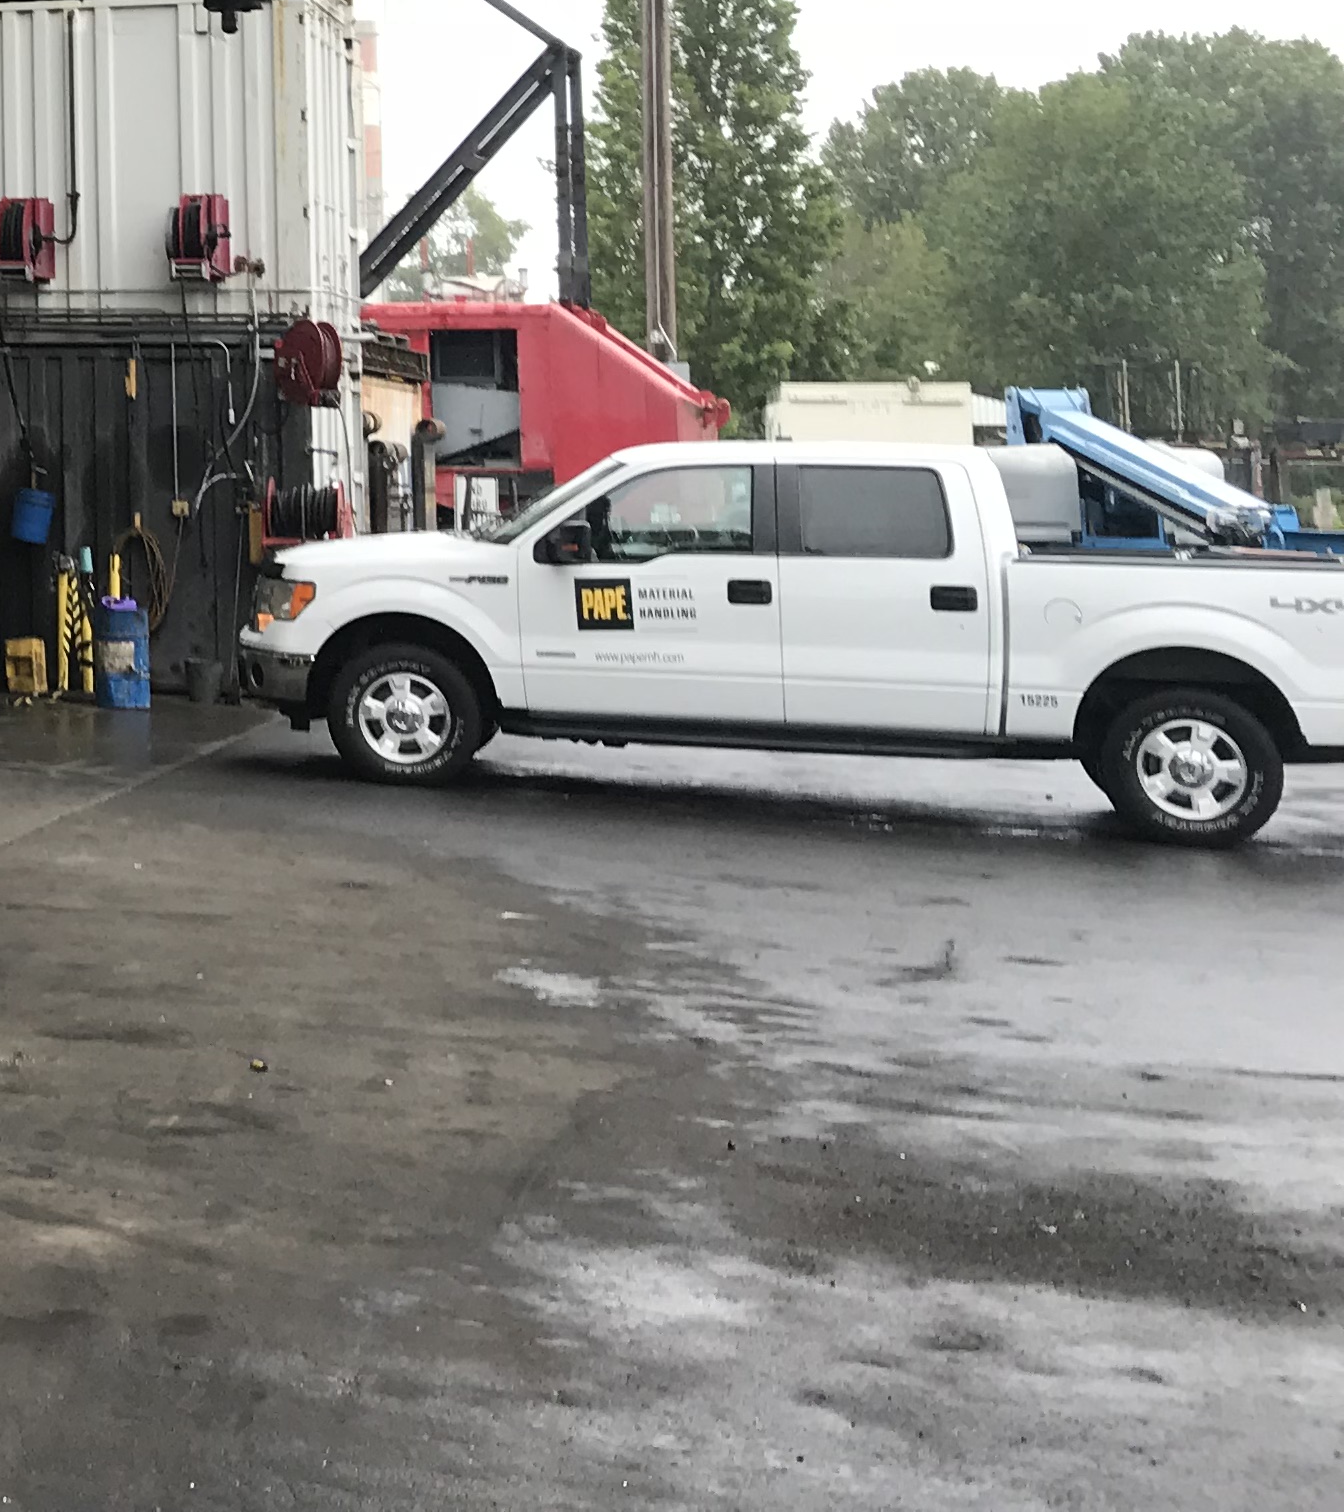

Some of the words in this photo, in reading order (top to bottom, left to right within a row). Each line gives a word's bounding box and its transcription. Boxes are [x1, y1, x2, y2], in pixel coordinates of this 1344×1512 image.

[638, 588, 695, 601] MATERIAL
[1269, 596, 1344, 615] 4X
[639, 607, 697, 620] HANDLING
